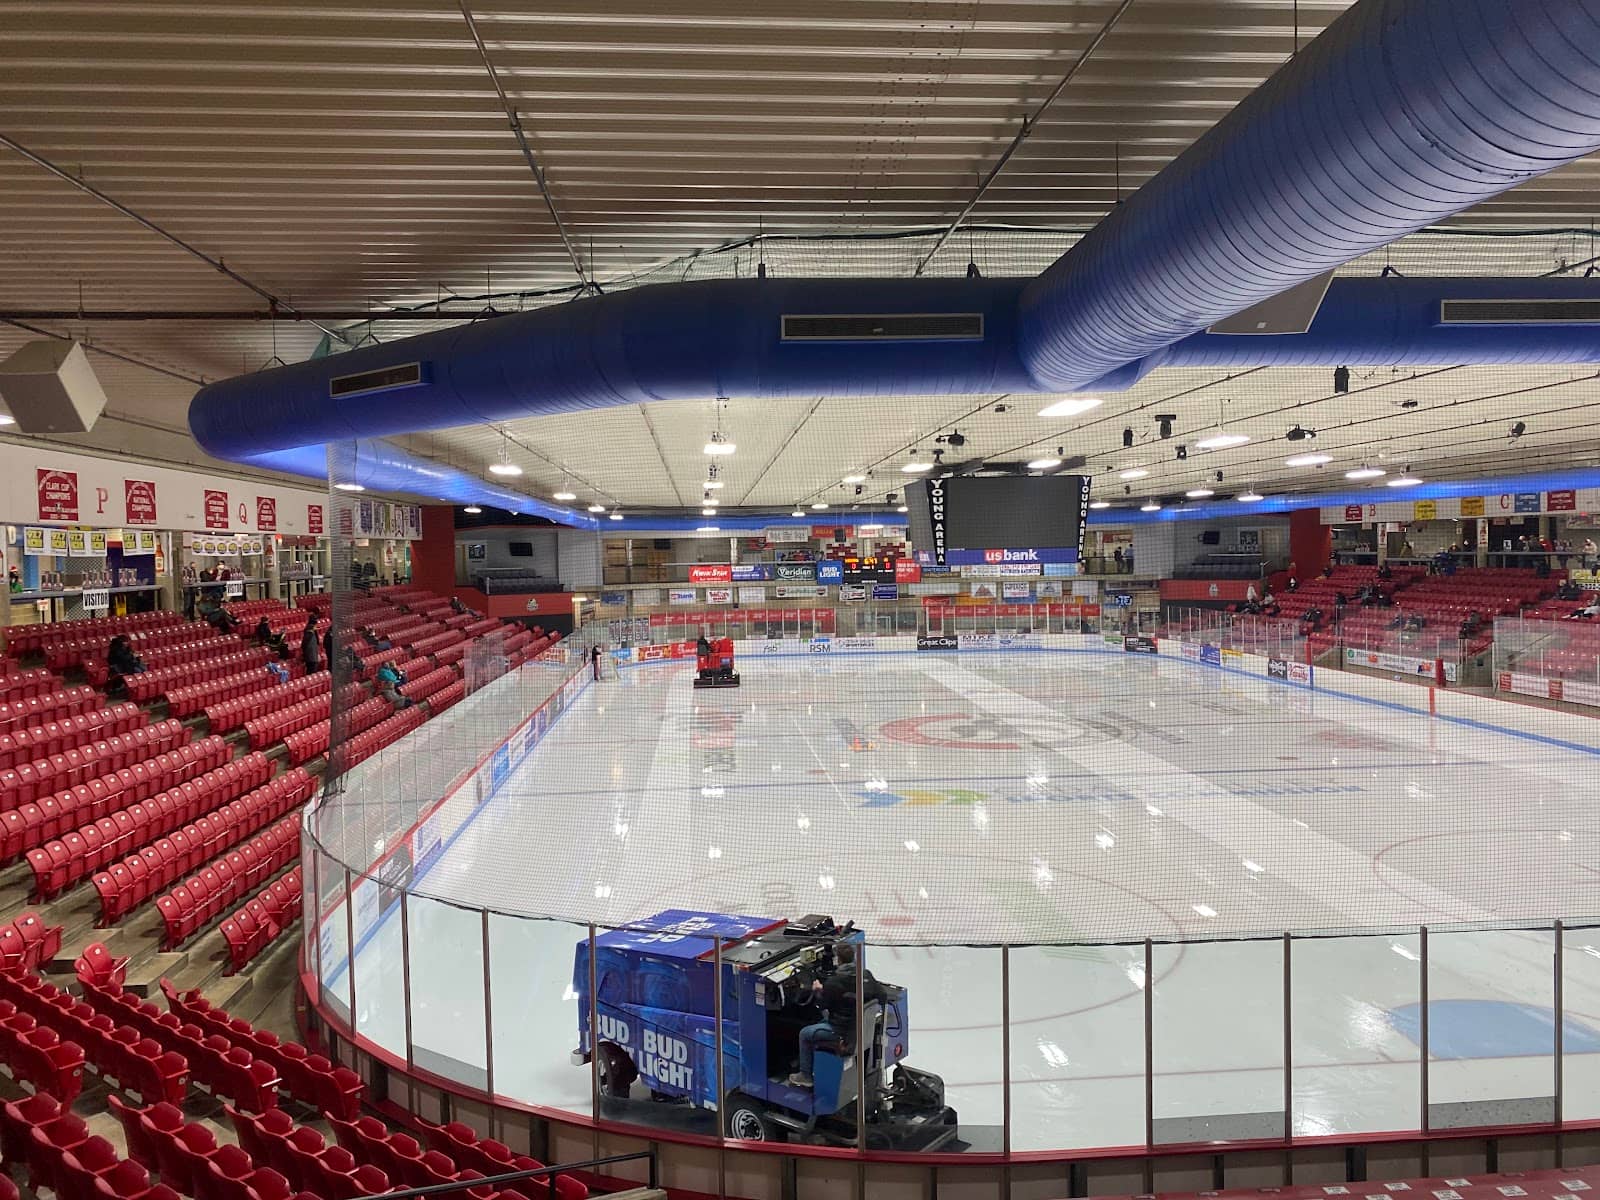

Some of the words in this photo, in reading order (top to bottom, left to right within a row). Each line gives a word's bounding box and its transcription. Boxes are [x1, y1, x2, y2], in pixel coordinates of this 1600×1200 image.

[96, 488, 109, 513] P
[930, 479, 944, 520] YOUNG
[1080, 476, 1090, 518] YOUNG
[1500, 493, 1510, 509] C
[238, 502, 248, 525] Q
[935, 523, 945, 562] ARENA
[1078, 519, 1086, 560] ARENA
[692, 568, 711, 577] KWIK
[777, 565, 812, 579] Veridian
[84, 592, 109, 607] VISITOR
[809, 644, 831, 653] RSM
[917, 639, 939, 647] Great
[939, 638, 957, 648] Clips
[643, 1029, 688, 1065] BUD
[638, 1050, 694, 1091] LIGHT
